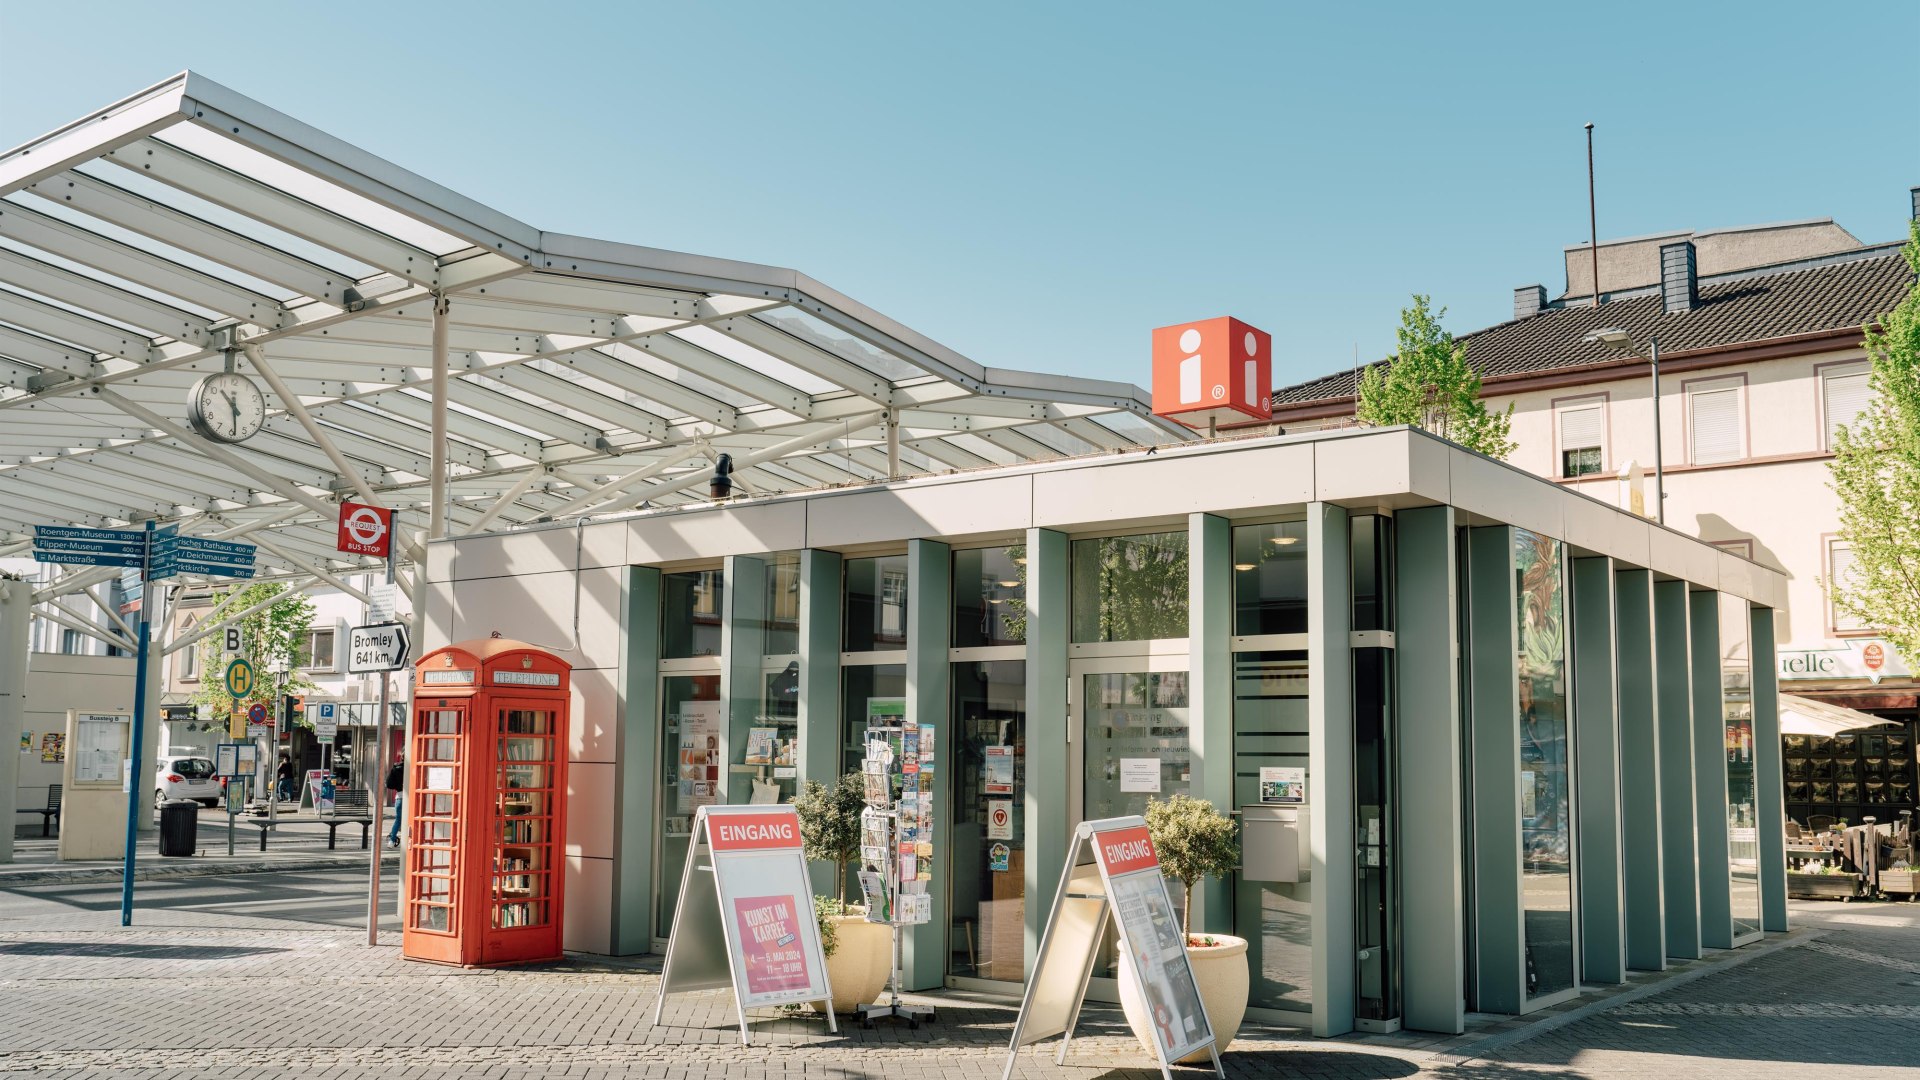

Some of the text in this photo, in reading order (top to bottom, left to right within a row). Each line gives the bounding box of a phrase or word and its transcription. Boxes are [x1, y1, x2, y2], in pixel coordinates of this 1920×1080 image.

[350, 521, 380, 531] REQUEST
[40, 528, 115, 539] Roentgen-Museum
[40, 540, 102, 551] Flipper-Museum
[204, 541, 232, 551] Rathaus
[363, 544, 380, 553] STOP
[48, 554, 96, 564] Marktstraße
[187, 551, 229, 561] Deichmauer
[178, 564, 210, 573] rktkirche
[227, 629, 239, 650] B
[354, 633, 393, 648] Bromley
[356, 651, 389, 665] 641 km
[234, 668, 246, 690] H
[427, 671, 472, 682] TELEPHONE
[496, 672, 555, 685] TELEPHONE
[324, 706, 331, 715] P
[720, 824, 792, 841] EINGANG
[1105, 840, 1150, 864] EINGANG
[744, 904, 788, 927] KUNST IM
[752, 921, 789, 943] KARREE
[773, 951, 784, 961] MAI
[785, 951, 800, 960] 2024
[767, 965, 773, 974] 11
[790, 962, 802, 972] UHR
